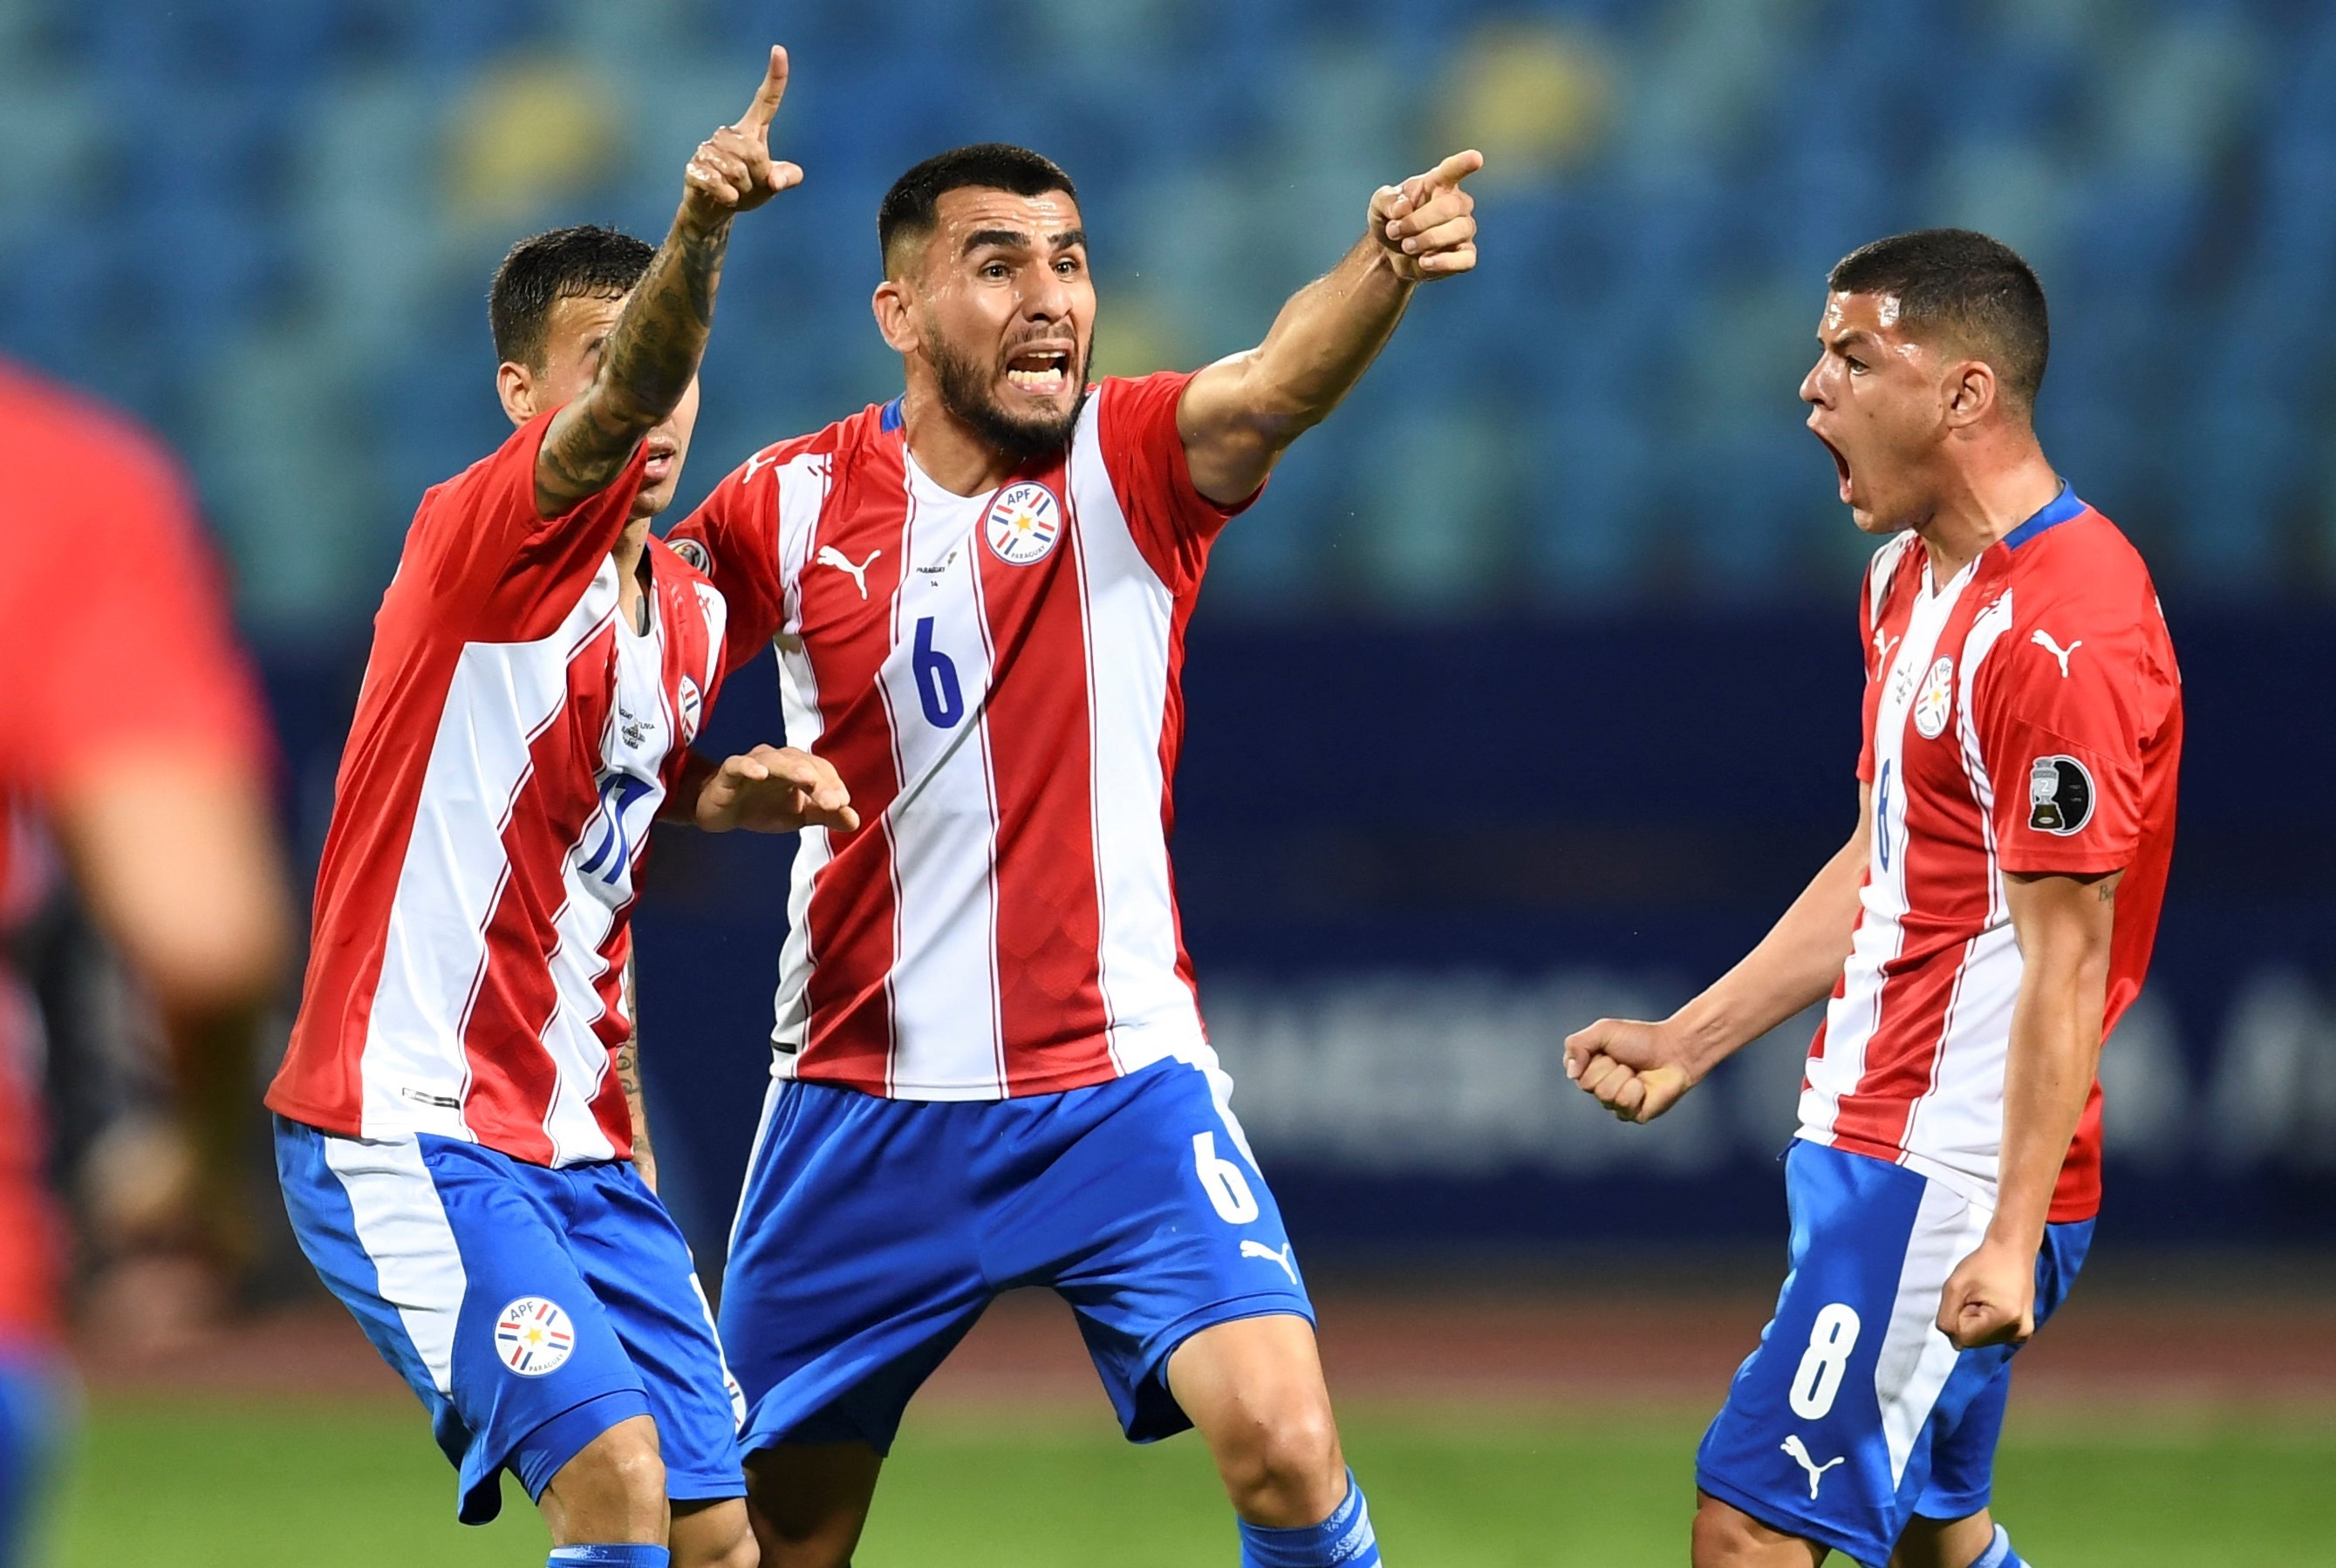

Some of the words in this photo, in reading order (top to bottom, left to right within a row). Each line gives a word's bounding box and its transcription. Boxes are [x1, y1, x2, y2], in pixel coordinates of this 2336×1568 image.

[1007, 487, 1031, 506] APF
[1010, 544, 1046, 559] PARAGUAY
[912, 616, 964, 729] 6
[2039, 779, 2050, 793] 2
[578, 773, 655, 885] 17
[1192, 1130, 1259, 1224] 6
[509, 1300, 535, 1321] APF
[529, 1353, 564, 1372] PARAGUAY
[1789, 1302, 1861, 1420] 8
